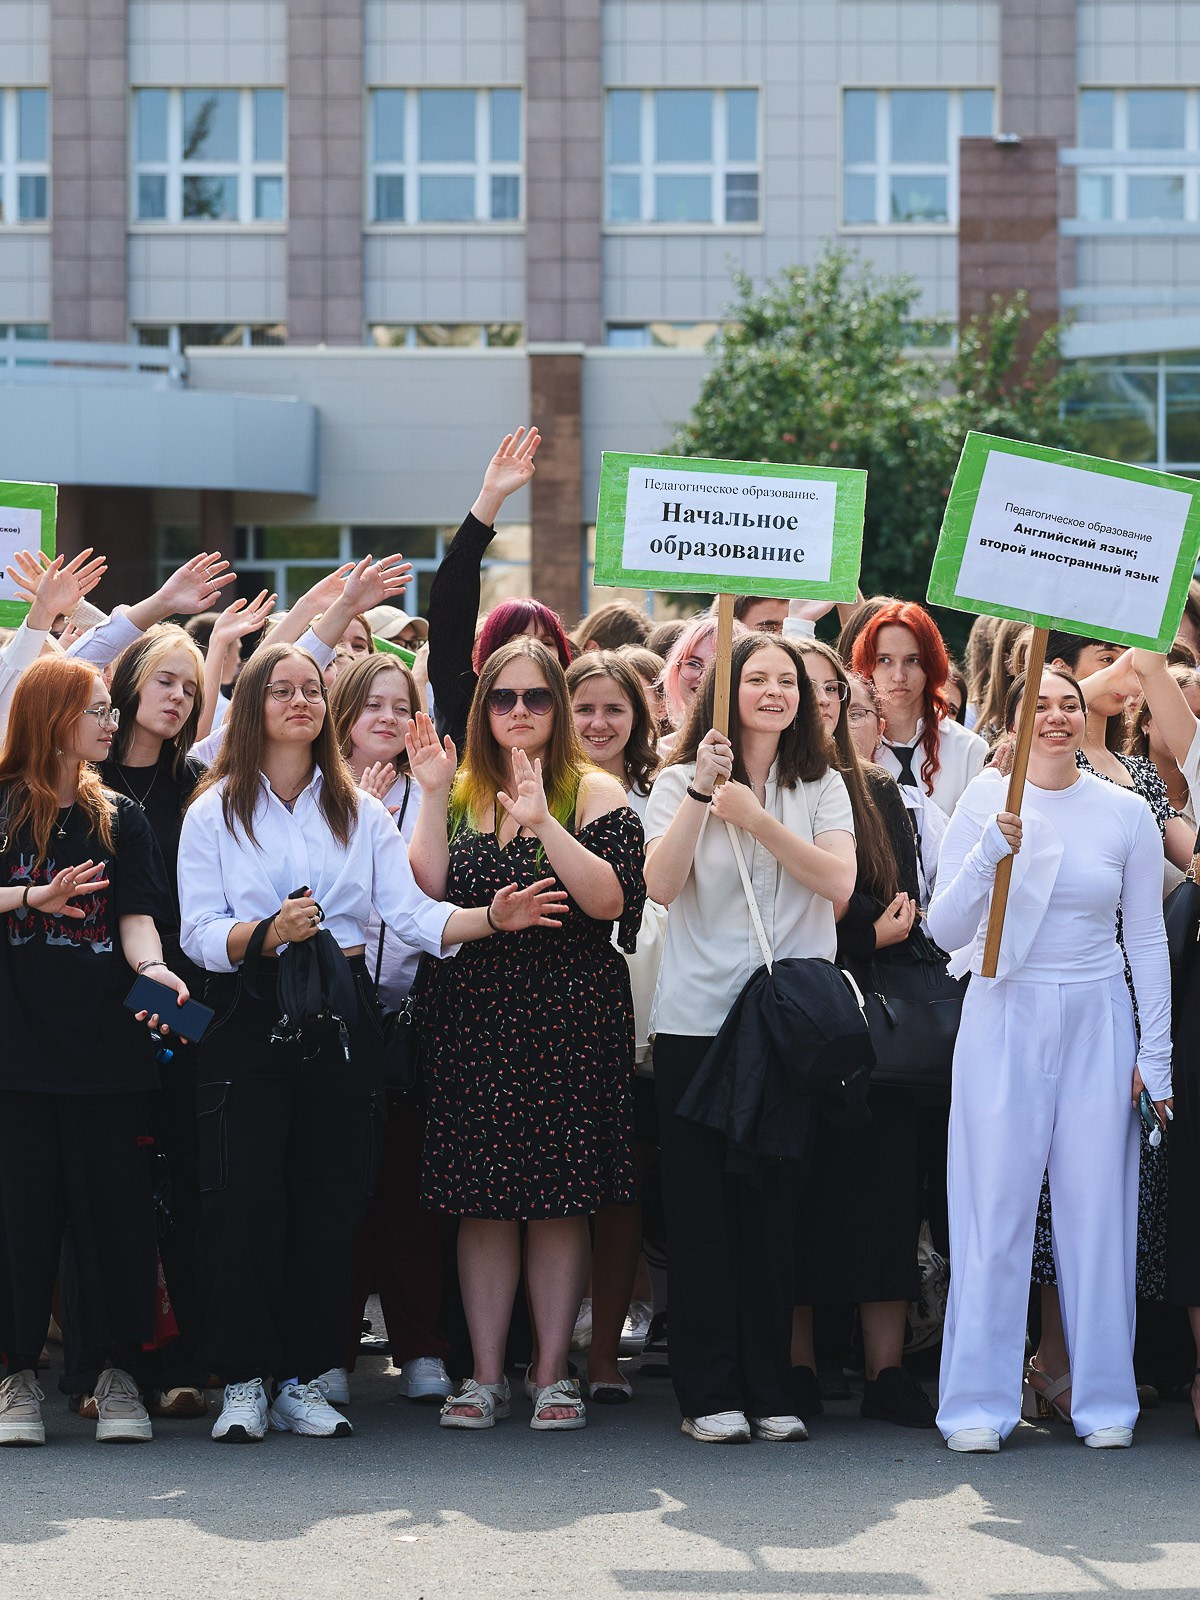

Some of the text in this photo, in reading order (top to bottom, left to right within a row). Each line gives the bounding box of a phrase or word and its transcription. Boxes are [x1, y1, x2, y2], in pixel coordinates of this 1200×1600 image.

[644, 477, 819, 501] Педагогическое образование.
[660, 501, 799, 531] Начальное
[1004, 502, 1153, 543] Педагогическое образование
[649, 534, 806, 563] образование
[1013, 522, 1138, 560] Английский язык;
[979, 537, 1160, 584] второй иностранный язык
